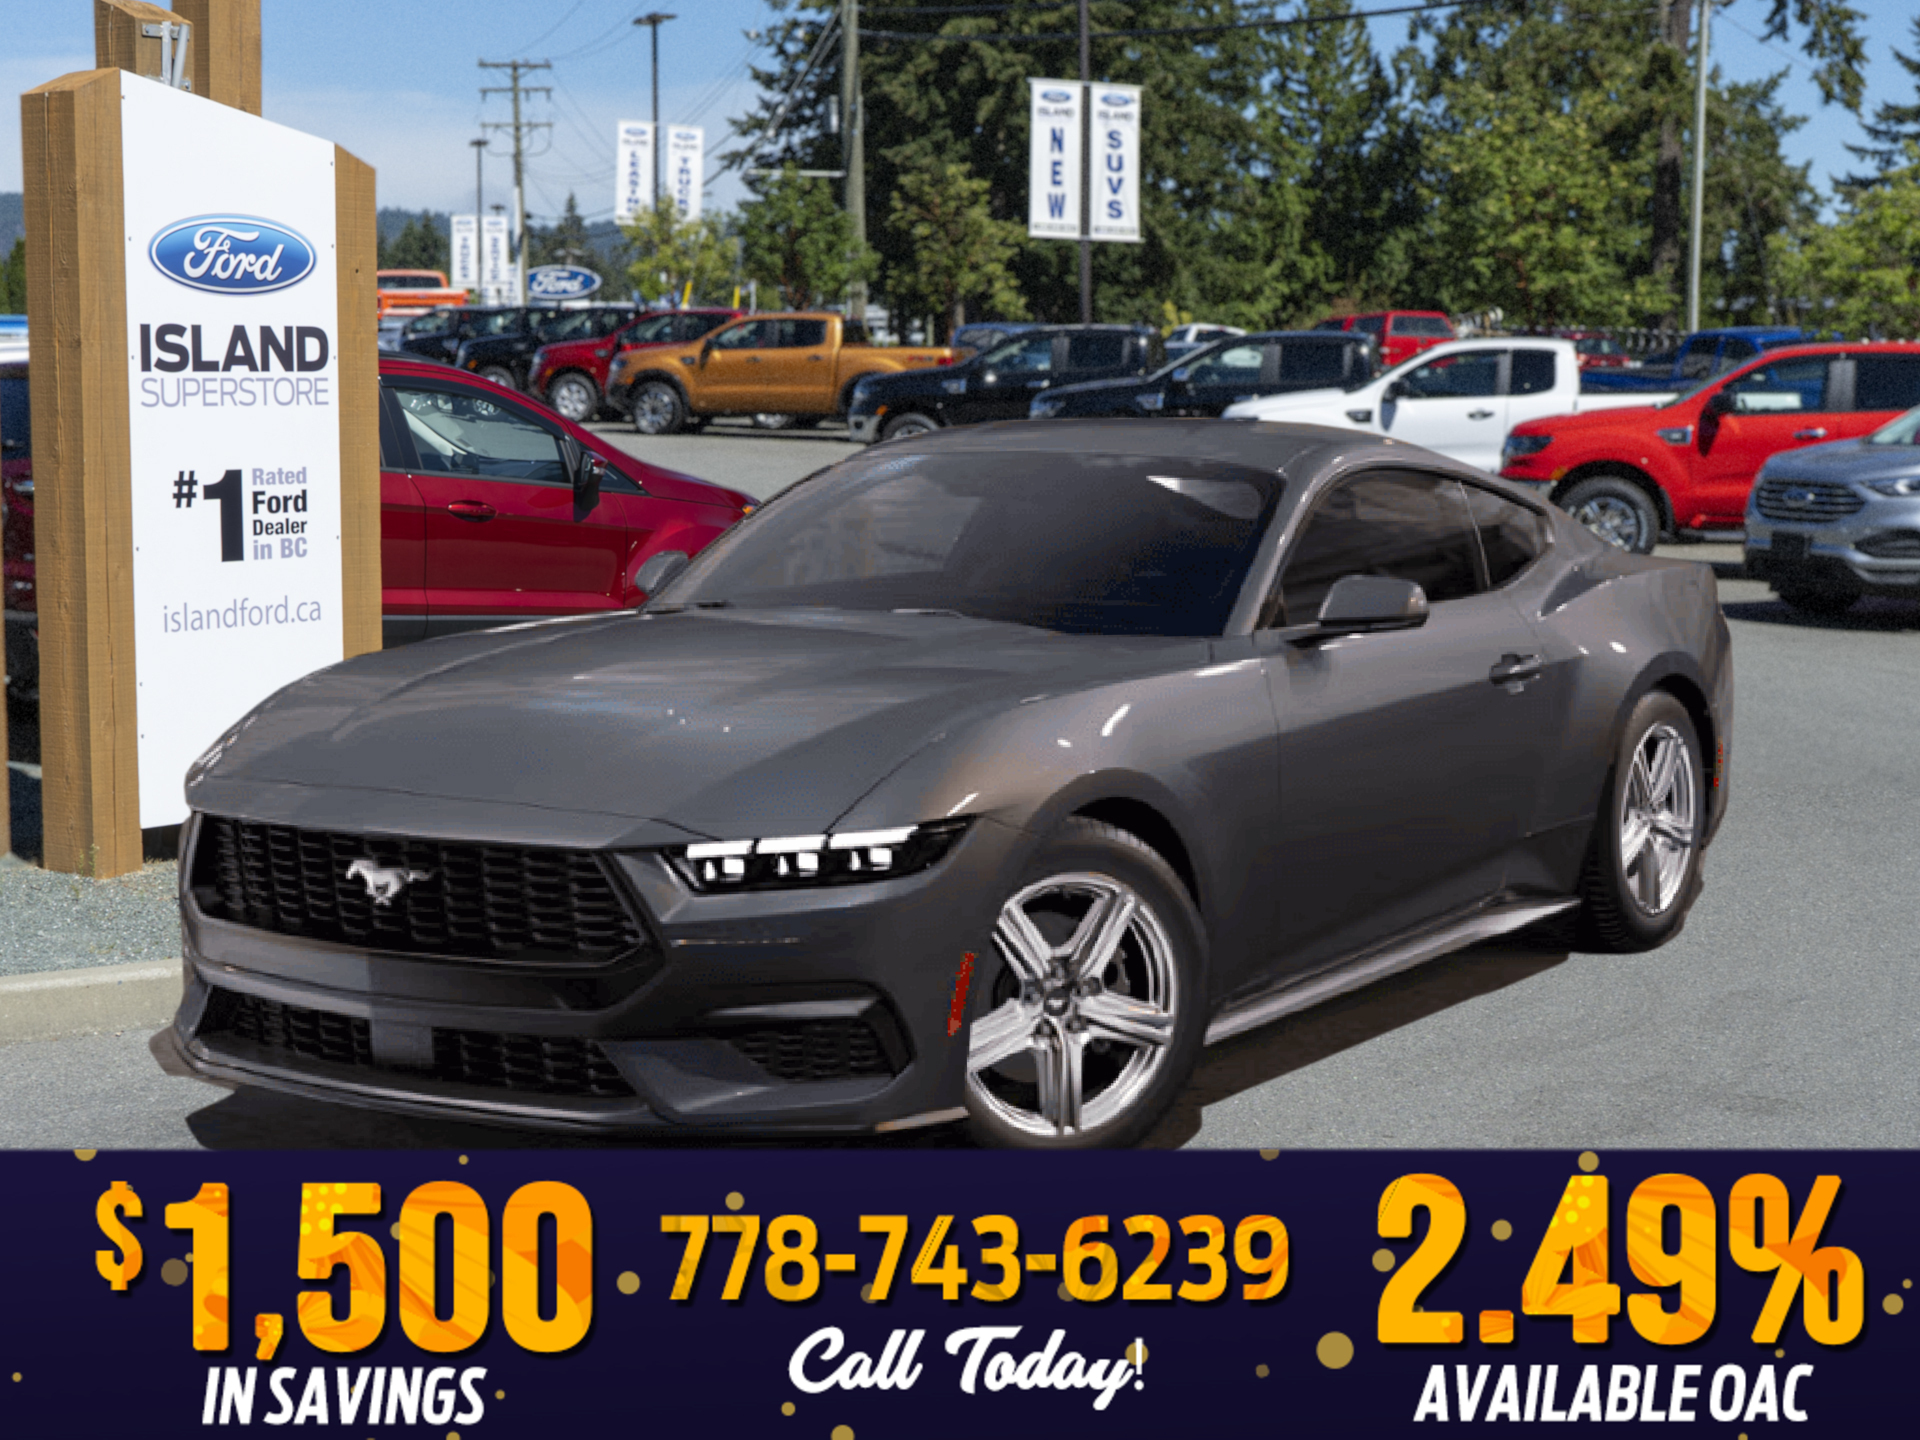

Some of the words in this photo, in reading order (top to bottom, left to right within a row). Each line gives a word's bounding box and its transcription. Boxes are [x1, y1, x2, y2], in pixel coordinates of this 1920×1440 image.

[1048, 127, 1066, 219] NEW
[1106, 129, 1124, 219] SUVS
[183, 225, 285, 282] Ford
[531, 270, 584, 293] Ford
[139, 322, 330, 373] ISLAND
[140, 377, 330, 408] SUPERSTORE
[251, 466, 308, 486] Rated
[172, 469, 245, 563] #1
[252, 489, 308, 515] Ford
[252, 518, 308, 536] Dealer
[253, 540, 273, 561] in
[280, 537, 308, 559] BC
[163, 595, 322, 634] islandford.ca
